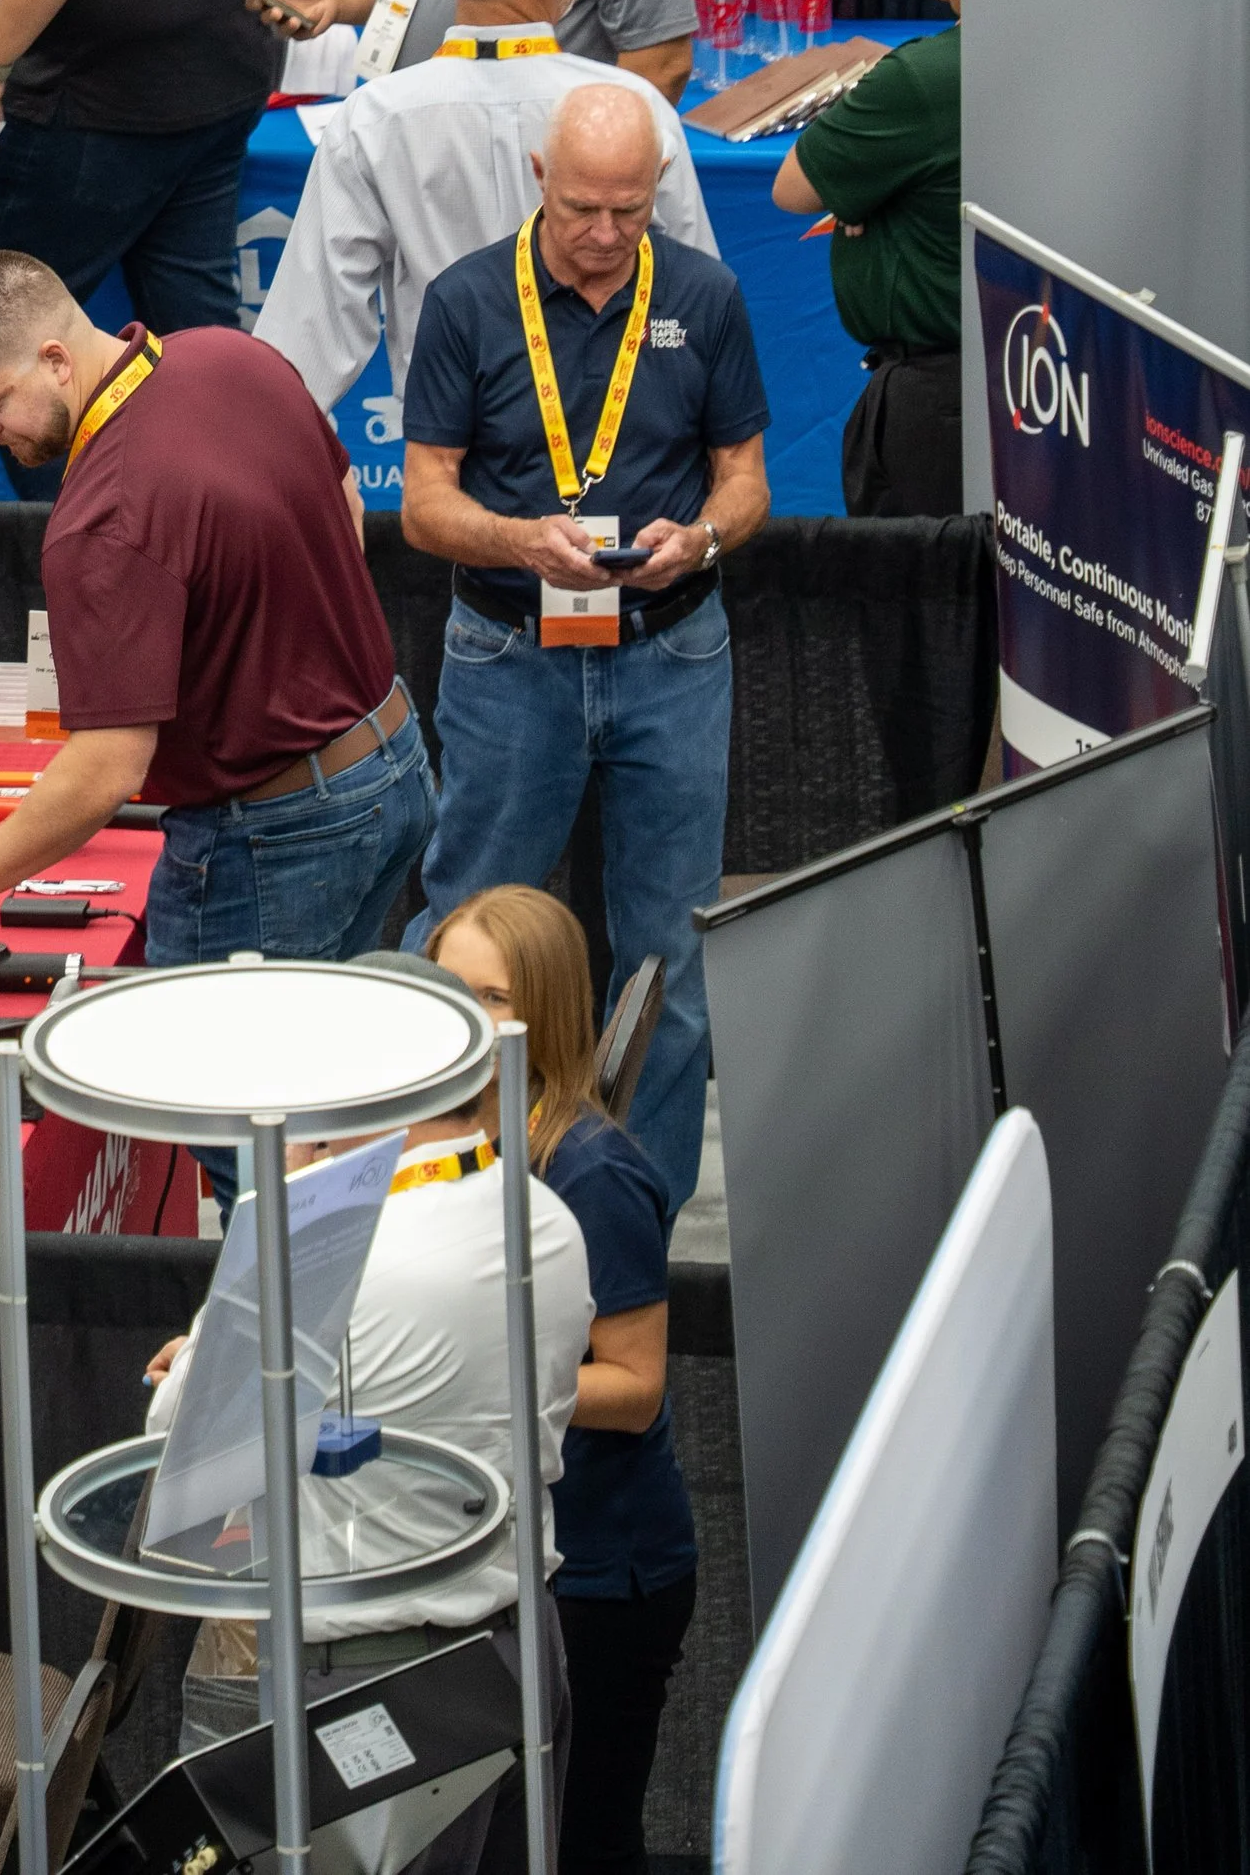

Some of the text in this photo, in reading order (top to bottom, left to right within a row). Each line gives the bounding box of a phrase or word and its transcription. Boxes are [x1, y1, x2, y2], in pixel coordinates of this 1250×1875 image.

[650, 318, 679, 329] HAND
[651, 328, 687, 338] SAFETY
[652, 337, 686, 349] TOOLS
[110, 387, 124, 404] 35
[1020, 334, 1090, 448] ION
[80, 428, 92, 445] 35
[1142, 438, 1215, 499] Unrivaled Gas
[1195, 500, 1215, 524] 87
[997, 499, 1057, 571] Portable,
[1058, 545, 1154, 620] Continuous
[1017, 559, 1072, 611] Personnel
[1074, 594, 1105, 627] Safe
[1106, 609, 1137, 645] from
